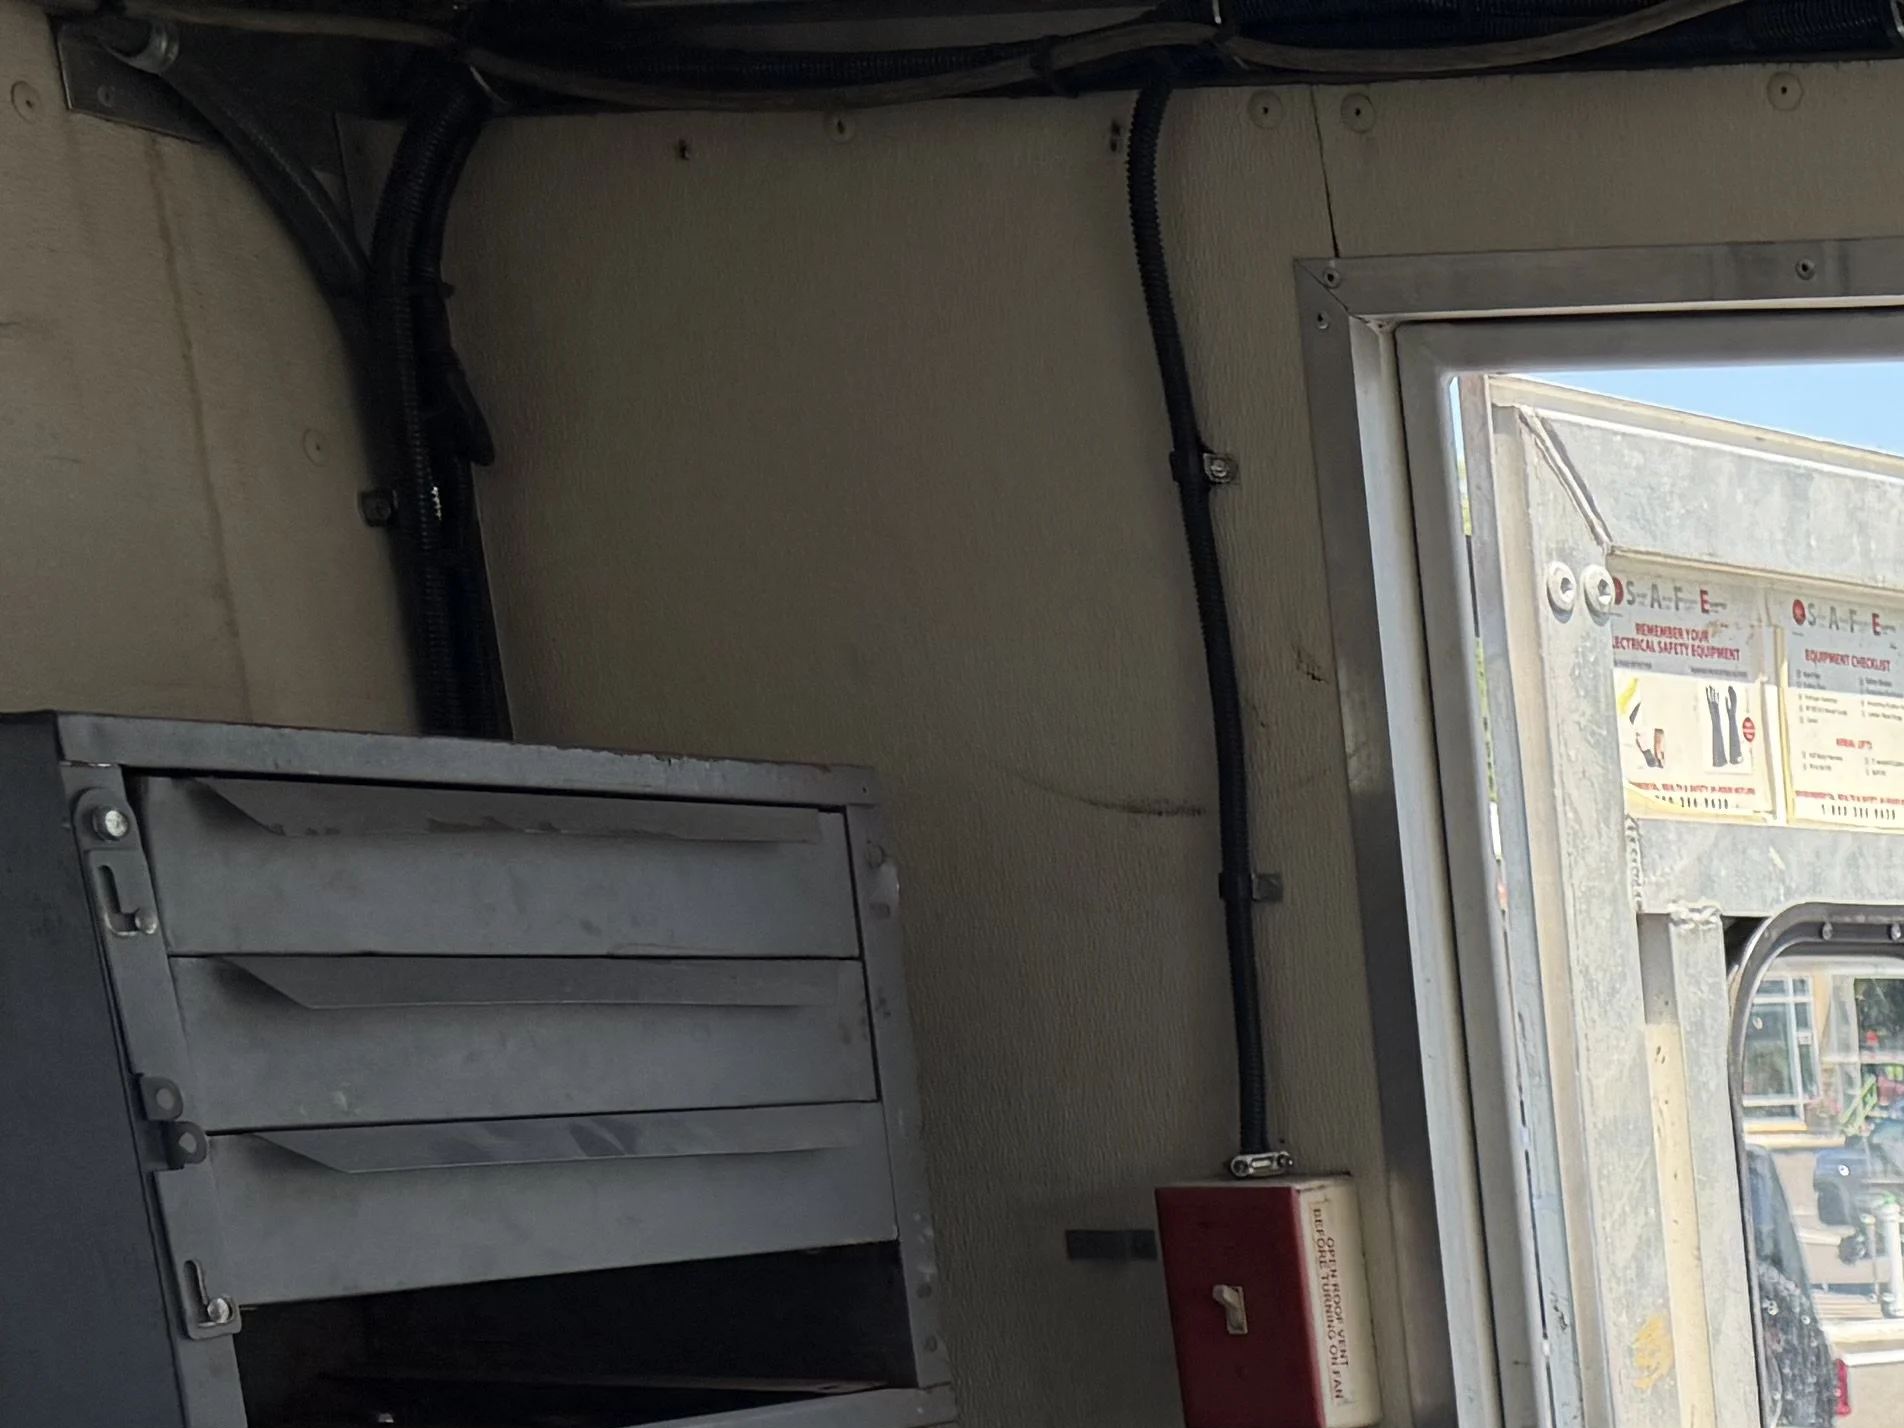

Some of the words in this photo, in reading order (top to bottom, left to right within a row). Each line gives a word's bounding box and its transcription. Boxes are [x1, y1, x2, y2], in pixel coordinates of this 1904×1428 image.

[1635, 622, 1684, 640] REMEMBER
[1686, 629, 1709, 643] YOUR
[1612, 636, 1655, 653] LECTRICAL
[1657, 641, 1689, 656] SAFETY
[1691, 645, 1740, 661] EQUIPMENT
[1805, 648, 1850, 667] EQUIPMENT
[1851, 658, 1891, 673] CHECKLIST
[1313, 1208, 1328, 1265] BEFORE
[1321, 1275, 1336, 1341] TURNING
[1326, 1237, 1337, 1277] OPEN
[1333, 1283, 1343, 1322] ROOF
[1338, 1330, 1349, 1366] VENT
[1329, 1346, 1339, 1366] ON
[1333, 1372, 1344, 1400] FAN
